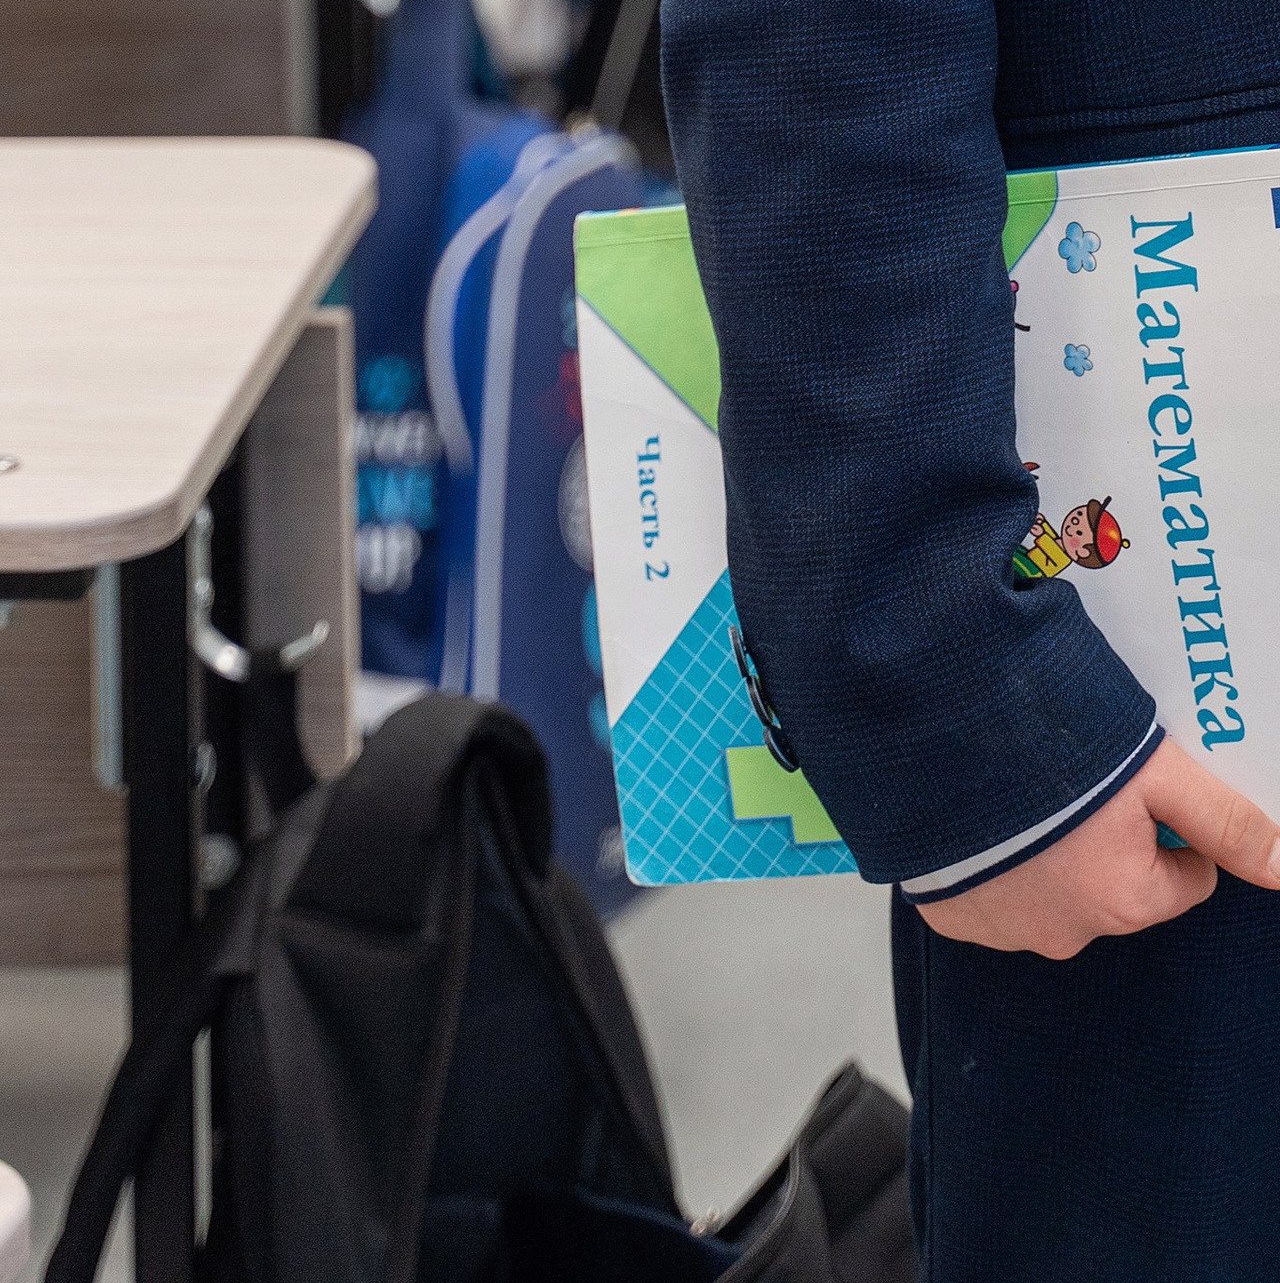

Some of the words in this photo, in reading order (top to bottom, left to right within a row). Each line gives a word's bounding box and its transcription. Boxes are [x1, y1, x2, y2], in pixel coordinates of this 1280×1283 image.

[637, 434, 661, 548] Часть
[1130, 212, 1245, 751] Математика
[645, 560, 670, 581] 2
